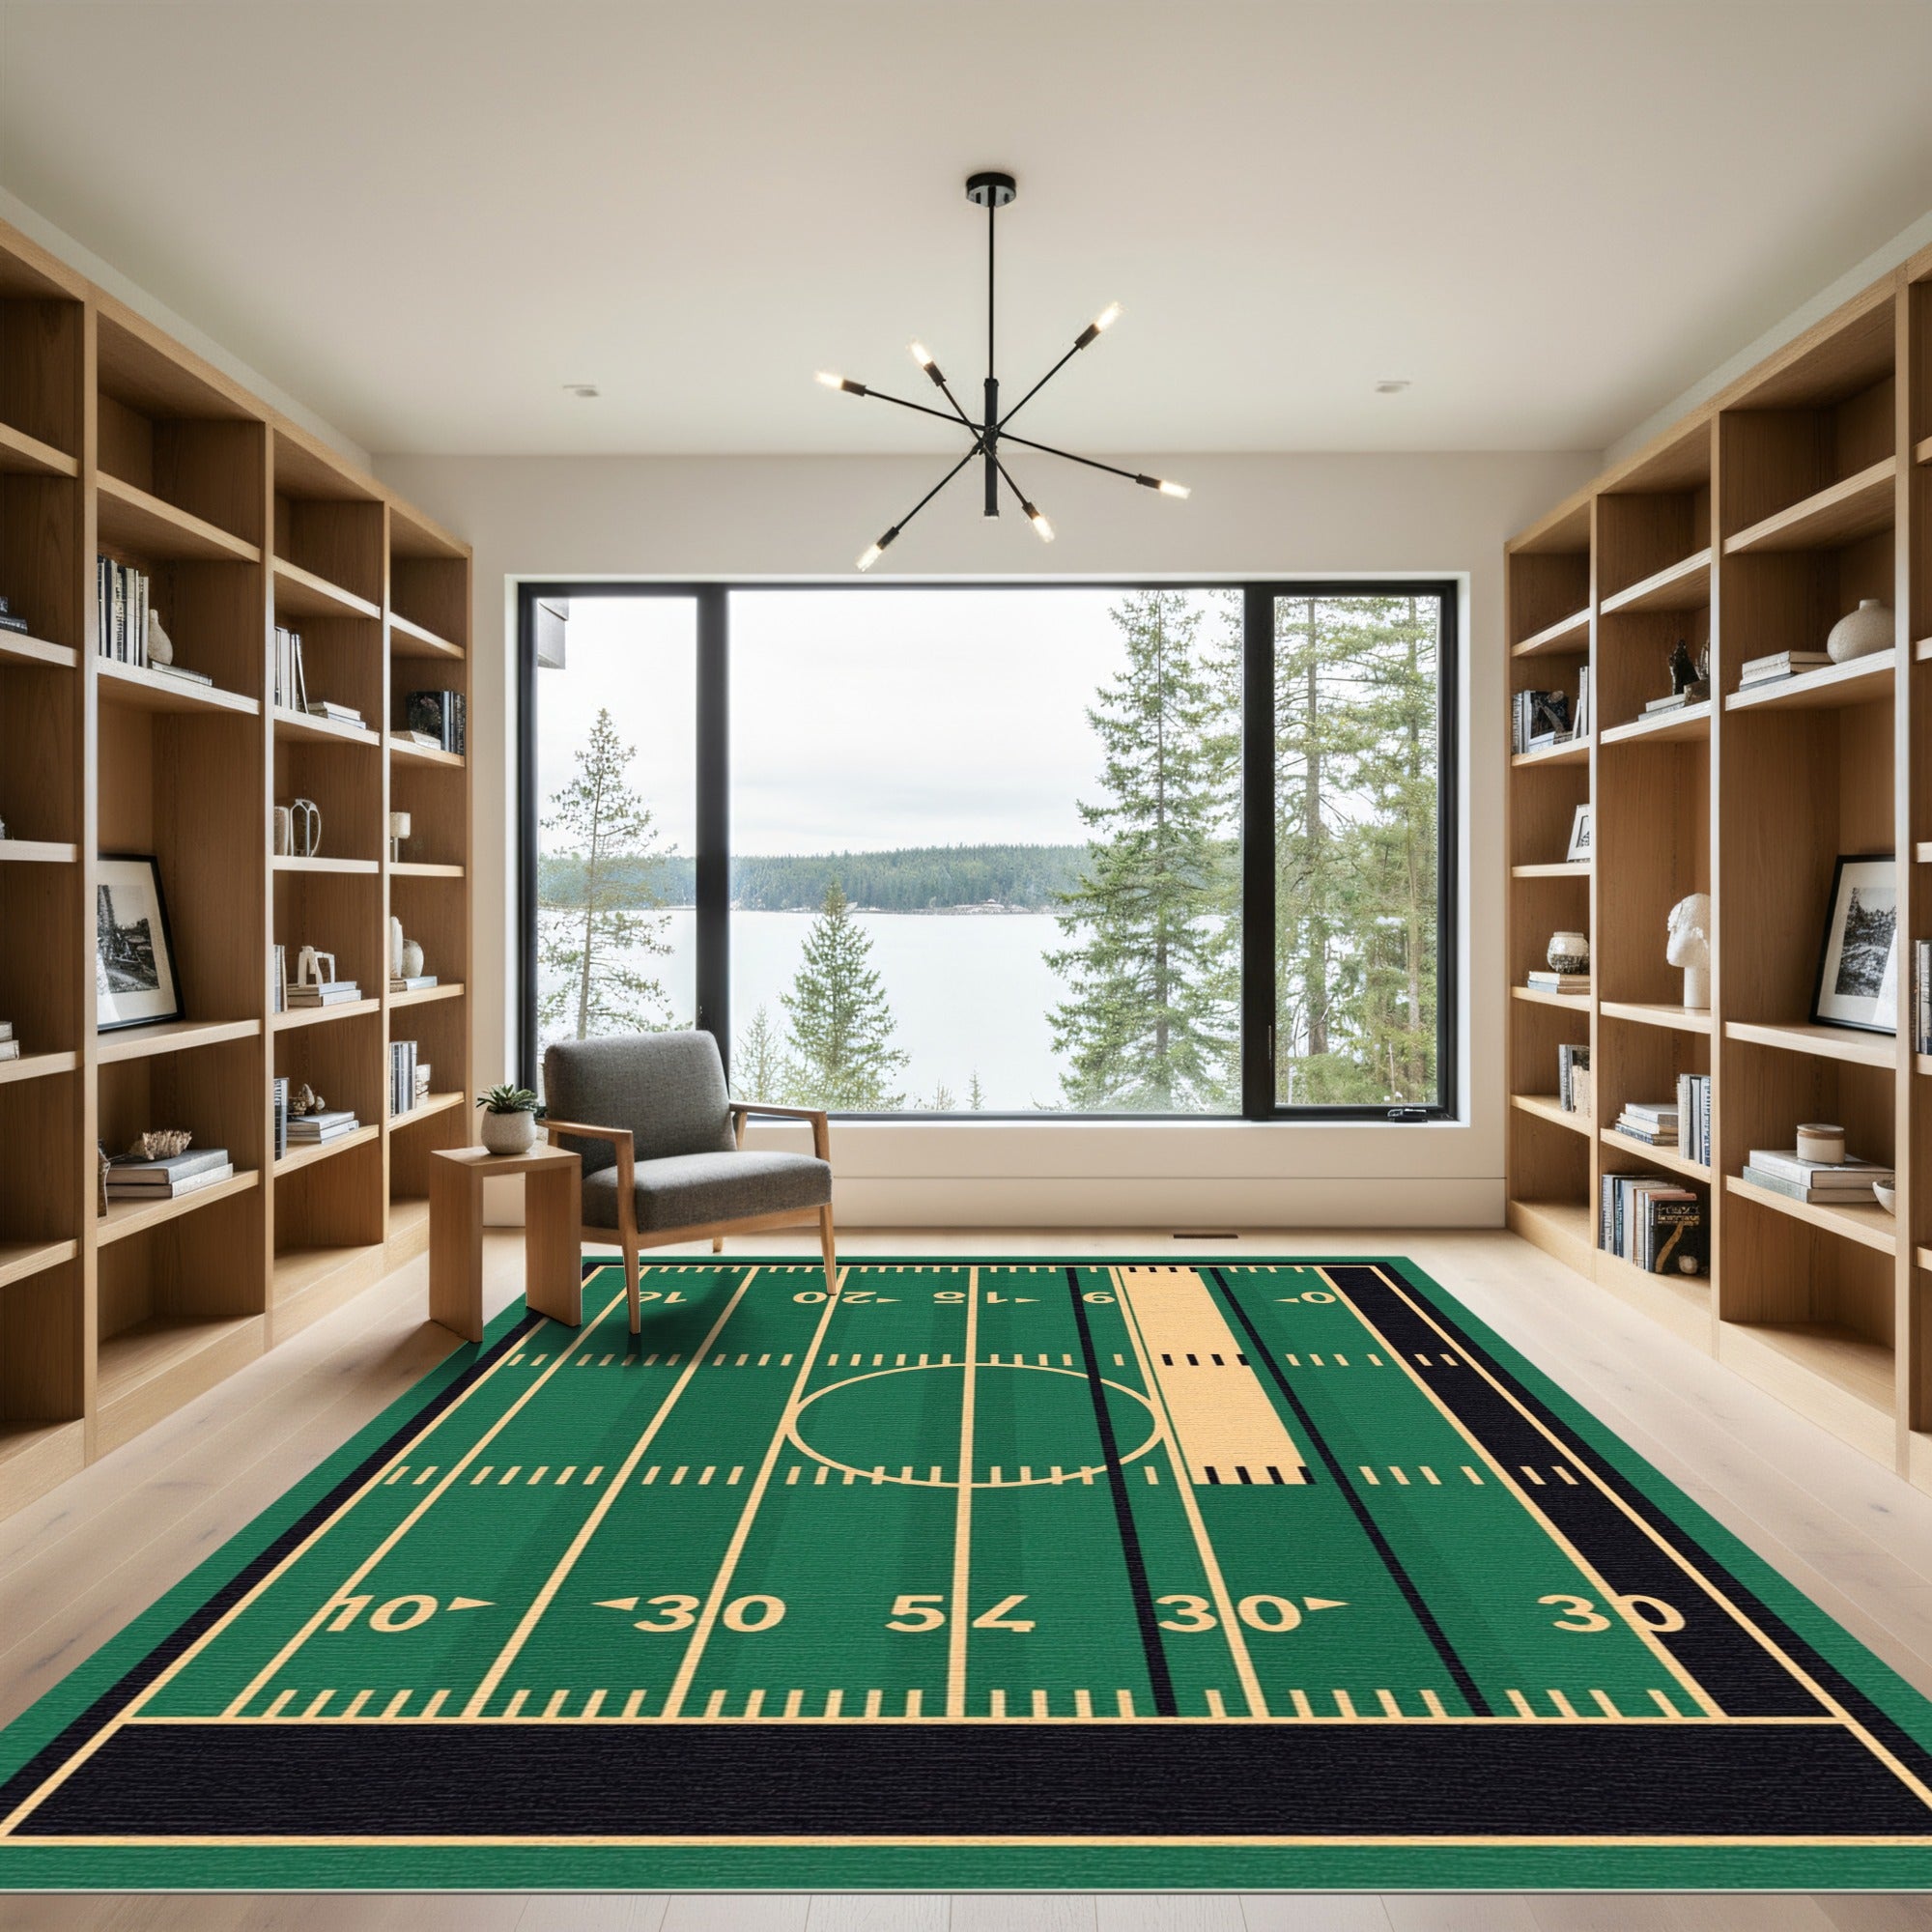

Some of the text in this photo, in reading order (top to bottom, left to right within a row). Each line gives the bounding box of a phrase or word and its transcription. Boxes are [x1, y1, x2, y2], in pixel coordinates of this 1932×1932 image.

[326, 1594, 439, 1633] 10
[633, 1594, 787, 1633] 30
[1155, 1594, 1303, 1633] 30
[1536, 1594, 1687, 1633] 30
